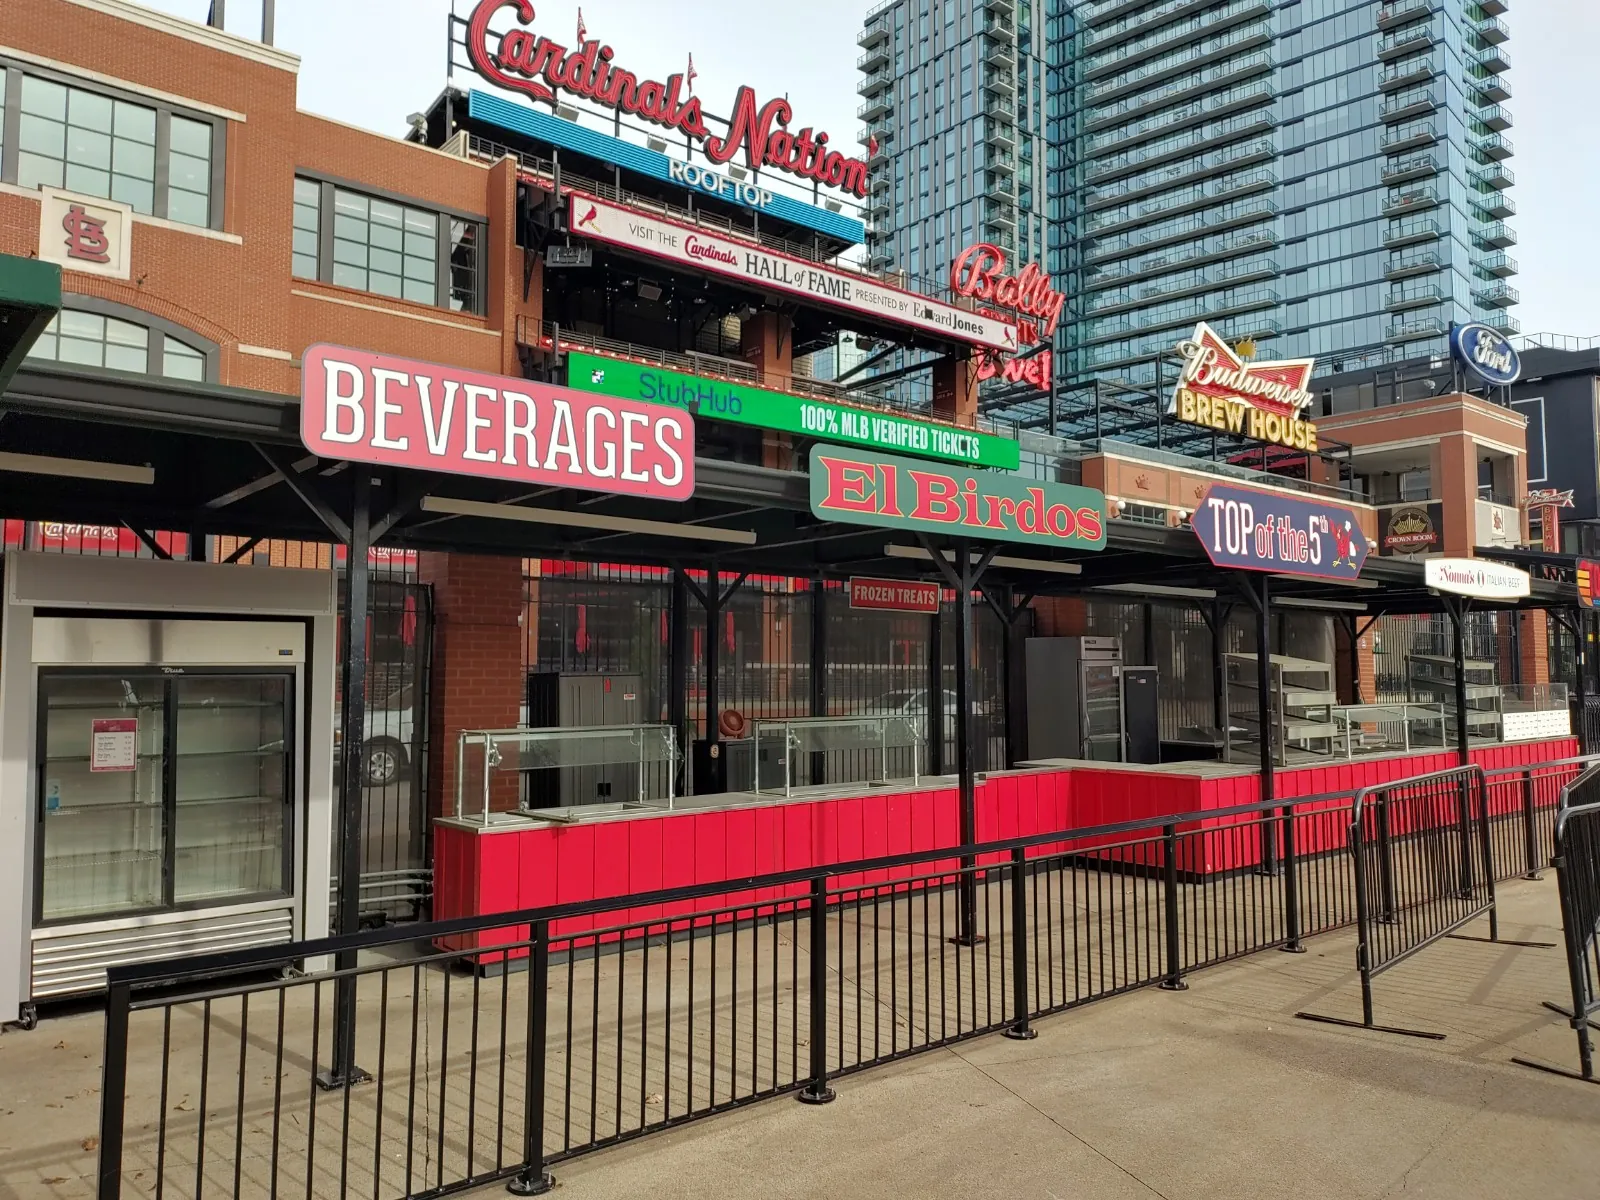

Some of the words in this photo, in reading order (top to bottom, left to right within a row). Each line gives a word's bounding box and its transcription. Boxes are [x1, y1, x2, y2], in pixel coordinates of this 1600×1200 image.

[466, 0, 711, 143] Cardinals
[703, 85, 868, 199] Nation
[668, 158, 773, 208] ROOFTOP
[629, 223, 655, 241] VISIT
[658, 231, 678, 247] THE
[684, 235, 738, 266] Cardinals
[745, 253, 793, 284] HALL
[794, 269, 806, 287] of
[808, 271, 852, 301] FAME
[855, 288, 897, 309] PRESENTED
[899, 300, 908, 312] BY
[951, 243, 1066, 336] Bally
[1177, 341, 1314, 408] Budweiser
[1474, 330, 1511, 373] Ford
[321, 358, 684, 488] BEVERAGES
[639, 372, 743, 416] StubHub
[1178, 388, 1246, 434] BREW
[1247, 407, 1318, 452] HOUSE
[800, 403, 839, 434] 100%
[841, 411, 869, 439] MLB
[872, 417, 929, 450] VERIFIED
[931, 428, 980, 460] TICKETS
[818, 456, 904, 517] El
[907, 469, 1103, 541] Birdos
[1208, 497, 1254, 556] TOP
[1255, 514, 1275, 559] of
[1277, 515, 1308, 563] the
[1387, 535, 1411, 544] CROWN
[1412, 534, 1433, 542] ROOM
[854, 585, 894, 603] FROZEN
[896, 588, 935, 605] TREATS
